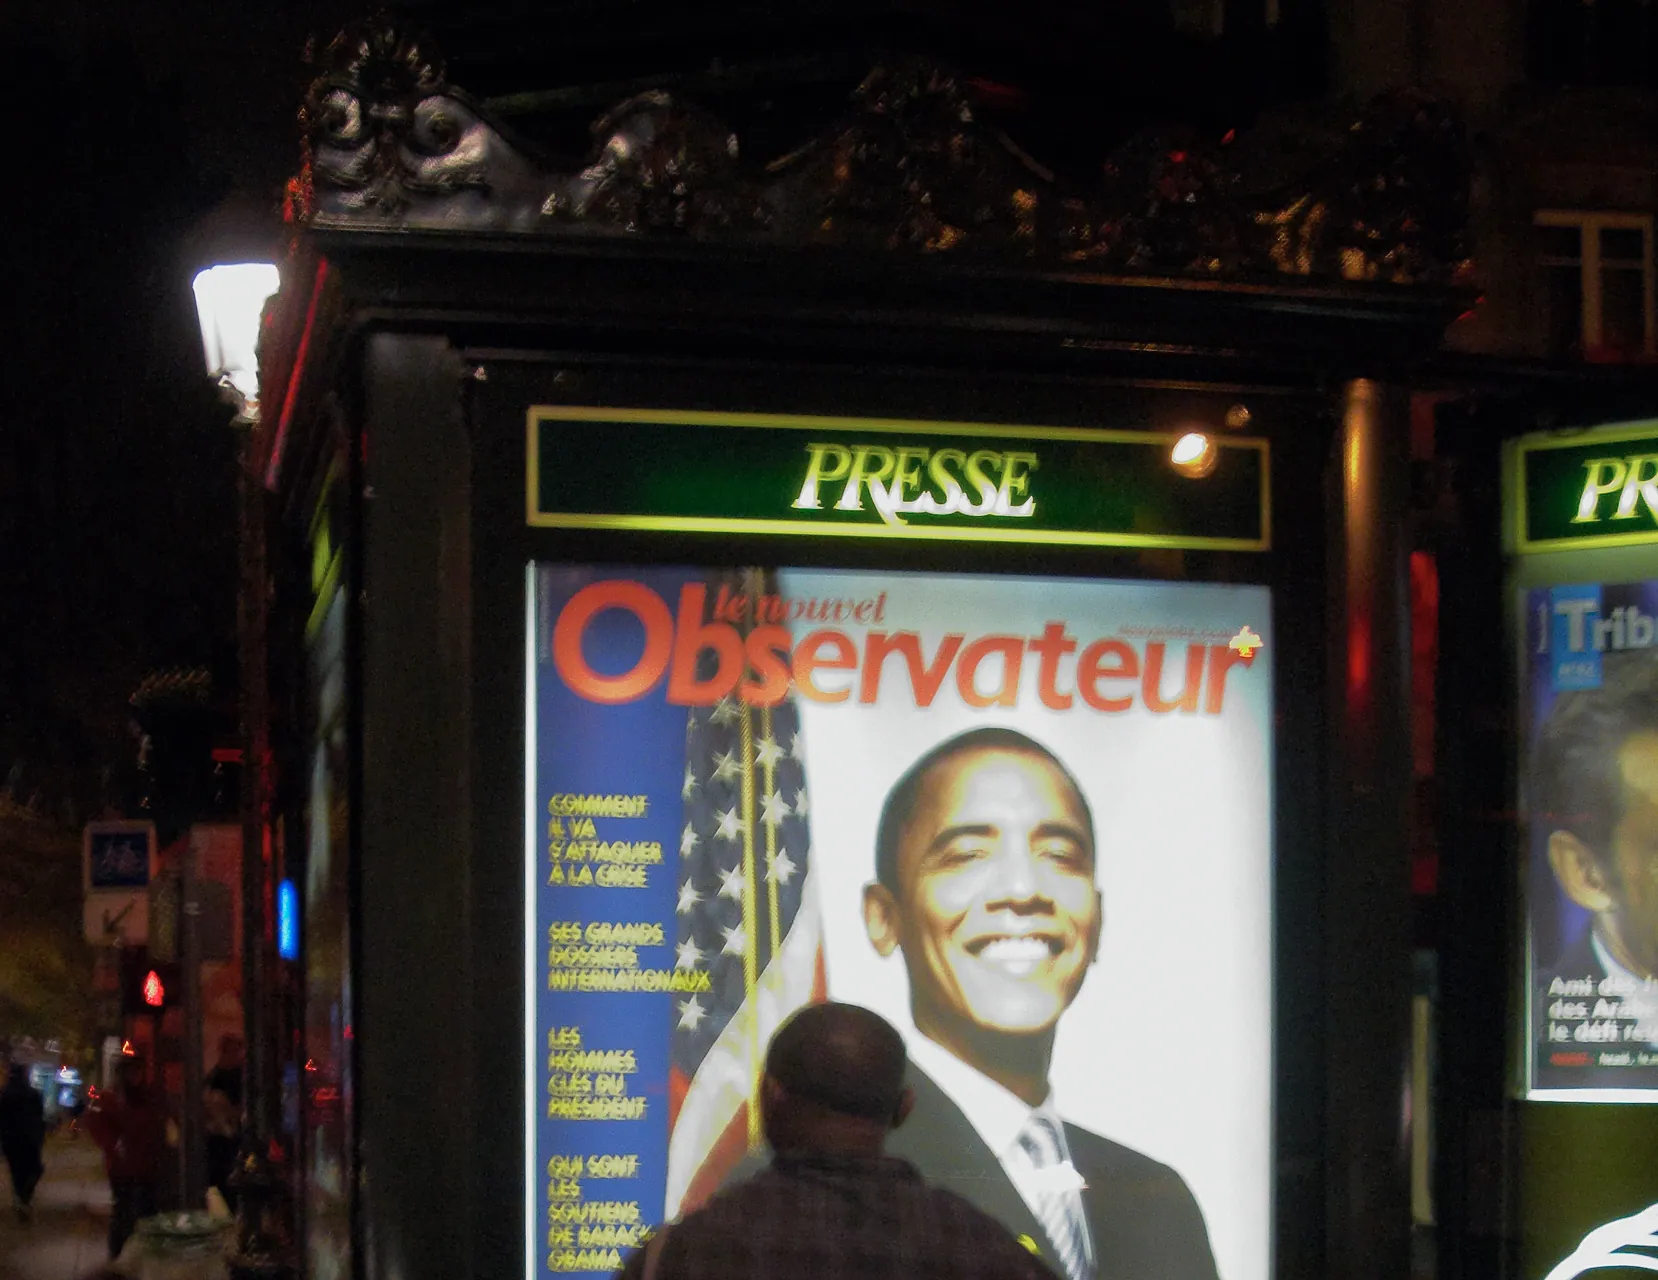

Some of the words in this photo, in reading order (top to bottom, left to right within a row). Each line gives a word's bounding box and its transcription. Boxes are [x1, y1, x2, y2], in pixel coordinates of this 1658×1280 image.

[791, 441, 1037, 526] PRESSE
[714, 583, 748, 622] le
[755, 590, 887, 625] nouvel
[1553, 597, 1658, 653] Trib
[552, 580, 1257, 716] Observateur
[548, 793, 650, 818] COMMENT
[568, 818, 598, 842] VA
[567, 864, 595, 886] LA
[584, 922, 666, 946] GRANDS
[548, 968, 713, 992] INTERNATIONAUX
[548, 1026, 582, 1049] LES
[548, 1050, 638, 1073] HOMMES
[548, 1179, 582, 1201] LES
[547, 1248, 624, 1272] OBAMA
